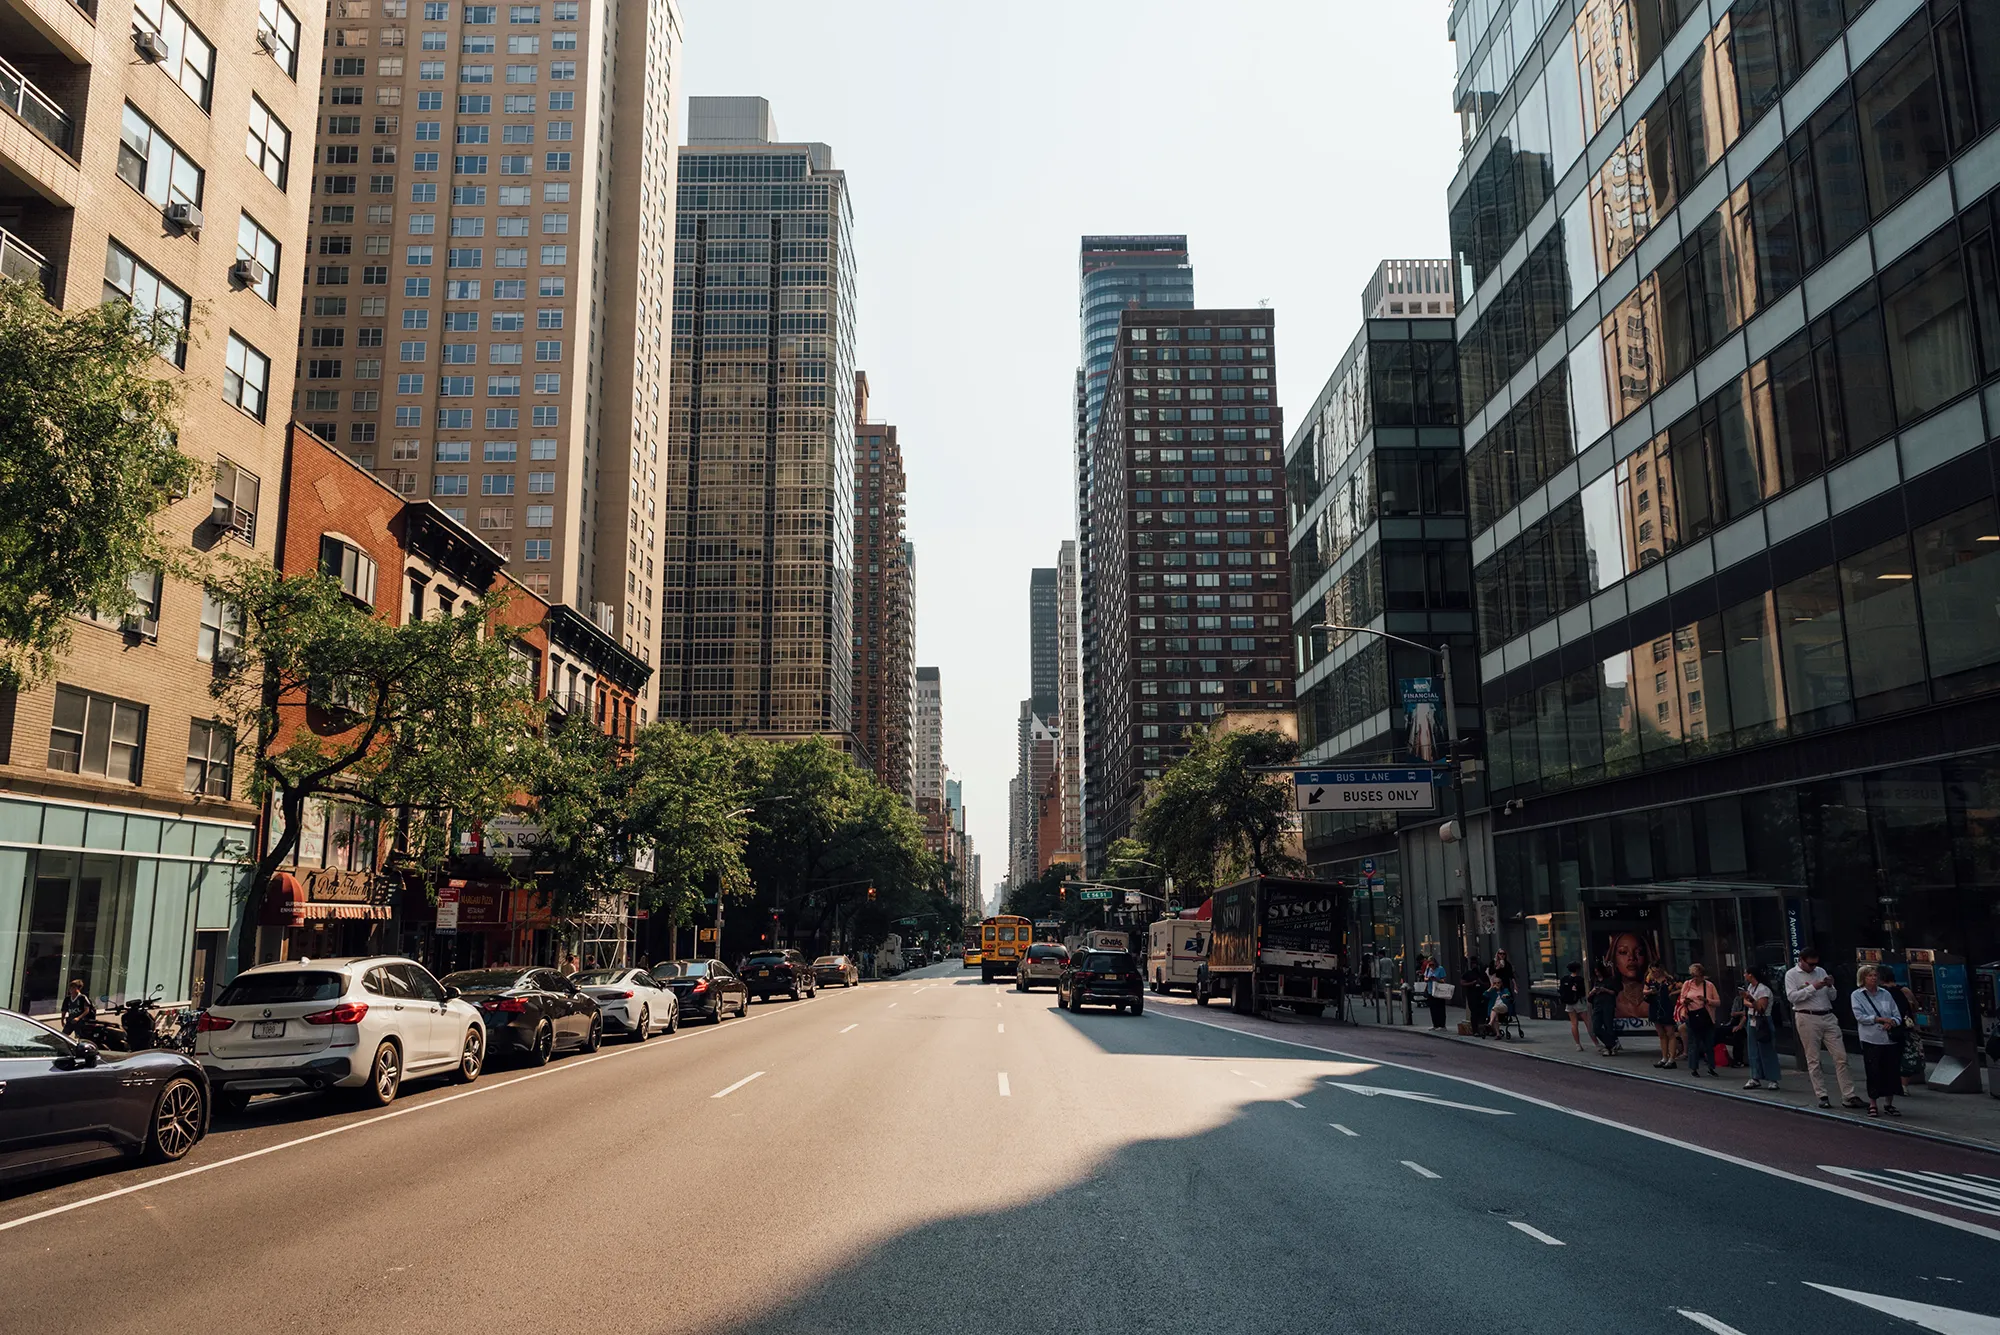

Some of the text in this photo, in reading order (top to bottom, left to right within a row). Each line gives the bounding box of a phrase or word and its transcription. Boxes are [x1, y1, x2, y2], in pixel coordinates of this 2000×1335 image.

[1336, 772, 1390, 781] BUS LANE
[1343, 789, 1419, 802] BUSES ONLY
[517, 832, 553, 844] ROYA
[1267, 899, 1332, 919] SYSCO
[1789, 916, 1799, 948] Avenue
[1100, 937, 1123, 945] CINTAS
